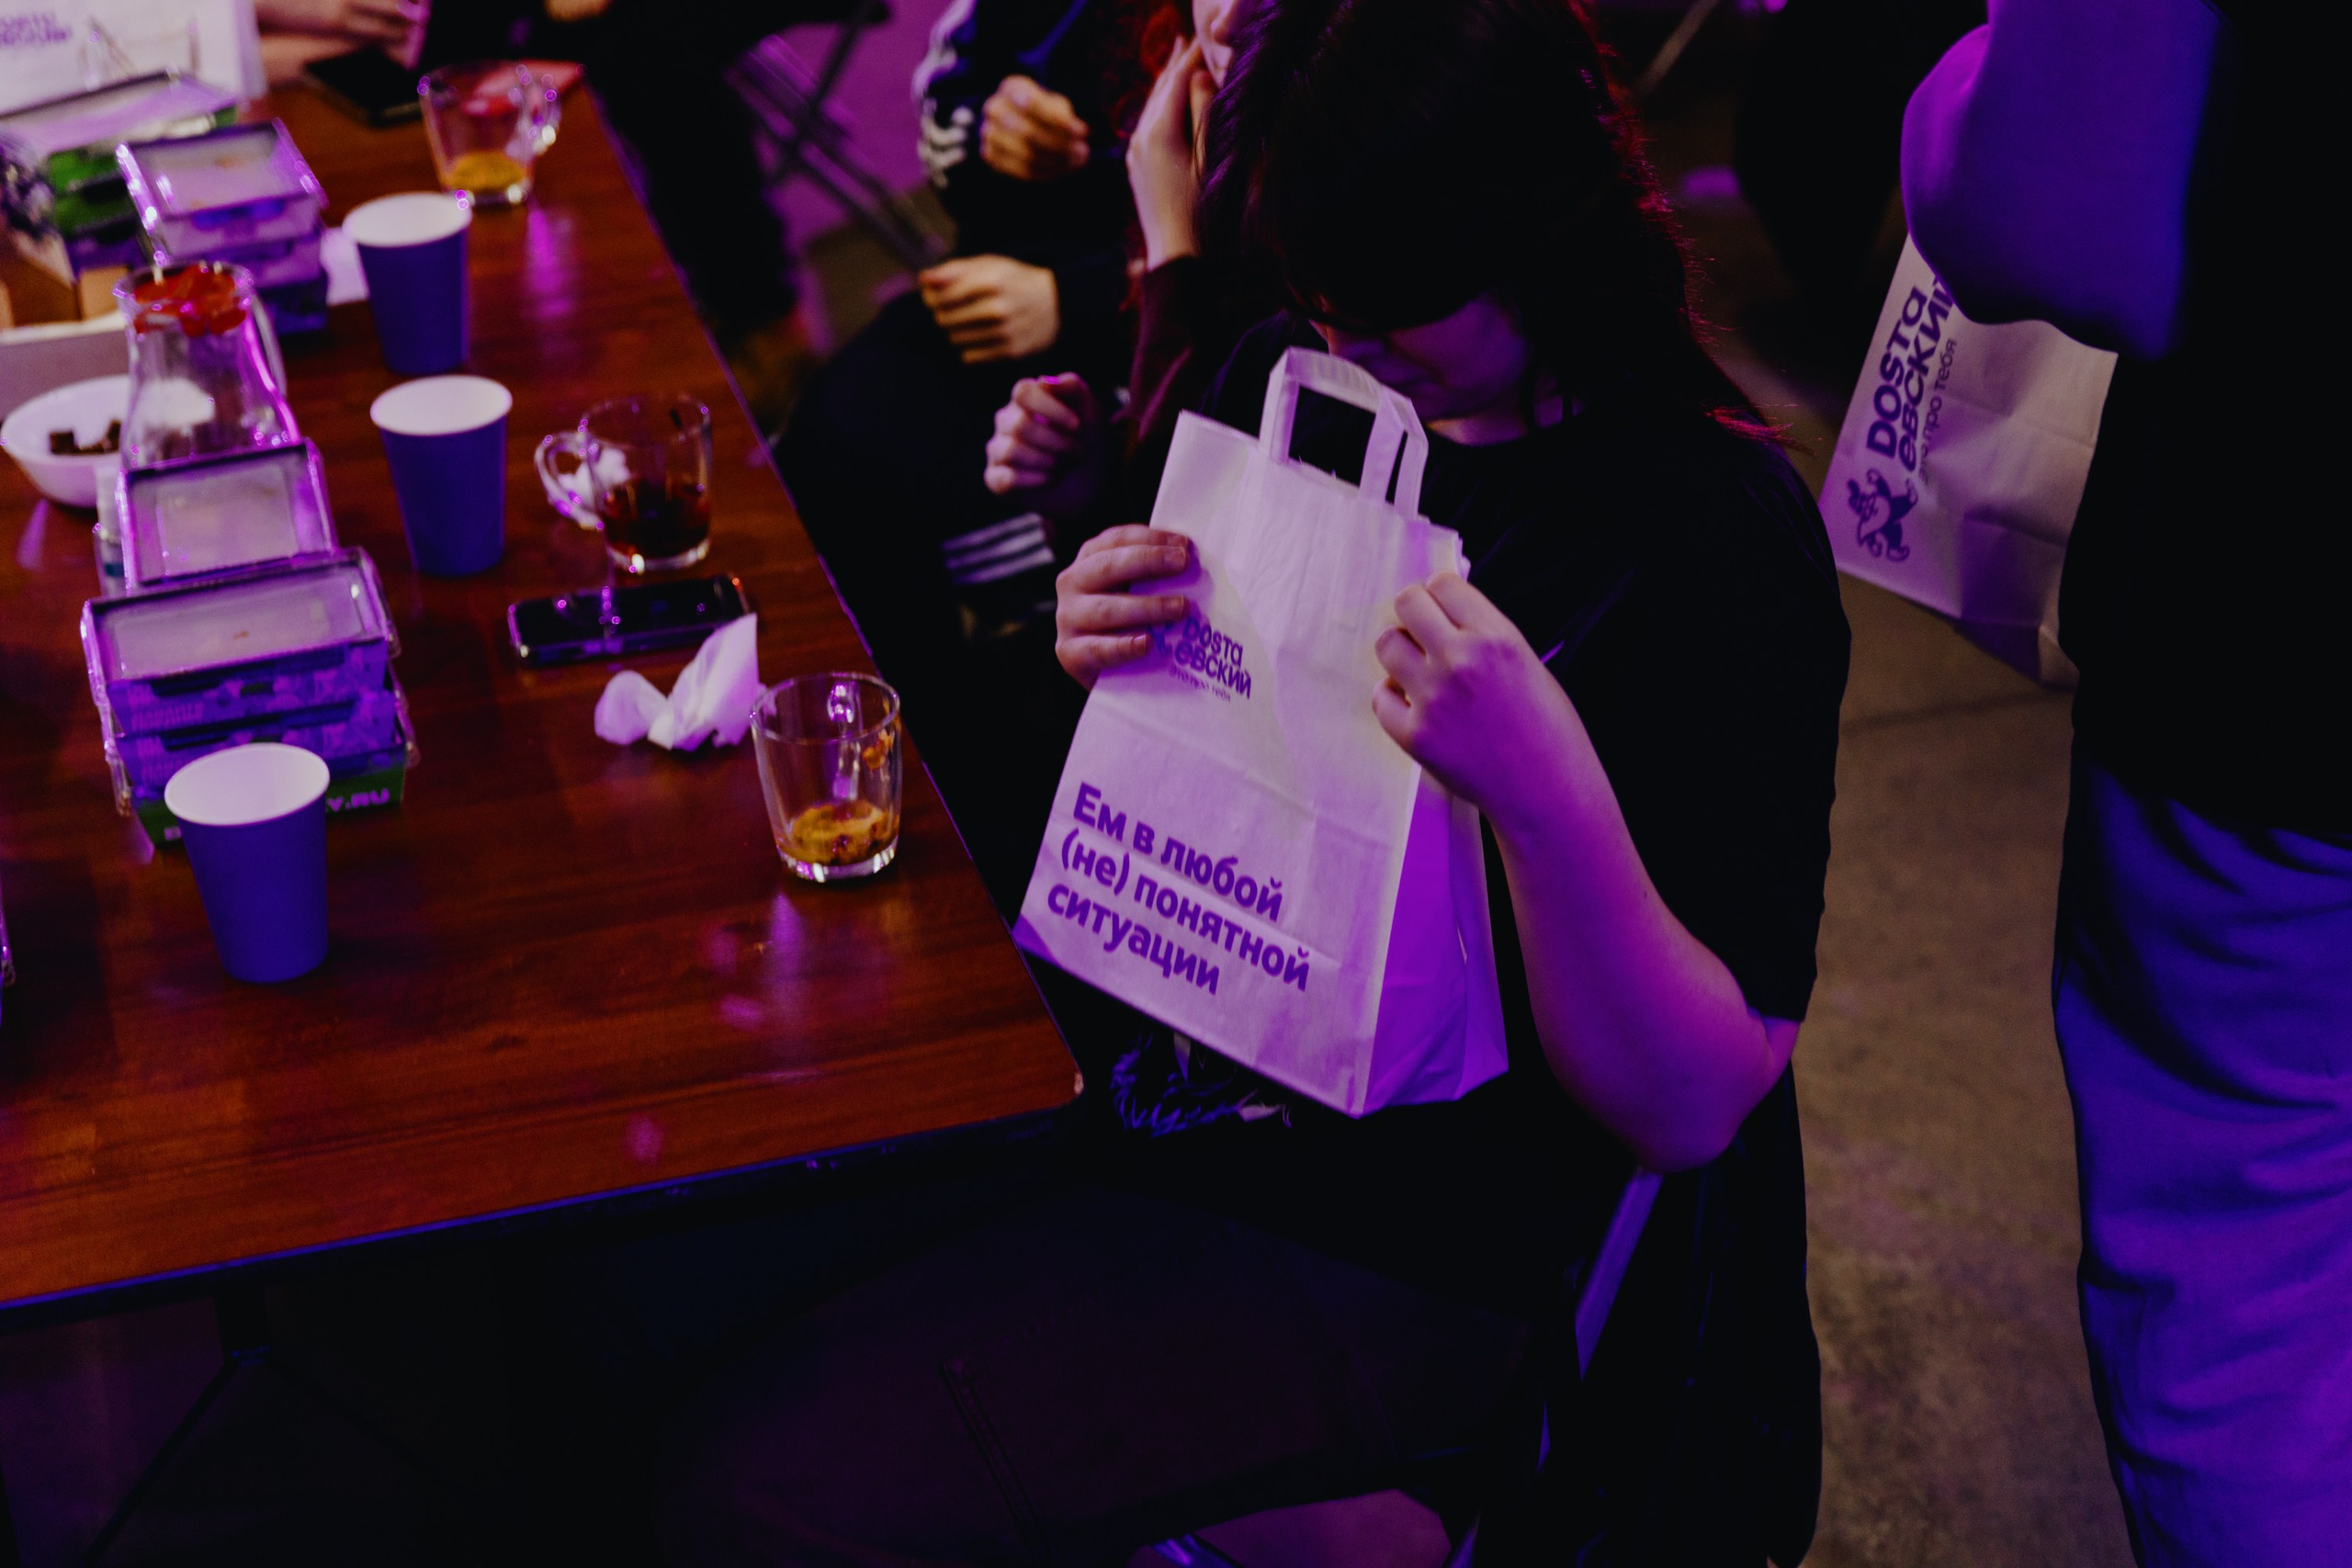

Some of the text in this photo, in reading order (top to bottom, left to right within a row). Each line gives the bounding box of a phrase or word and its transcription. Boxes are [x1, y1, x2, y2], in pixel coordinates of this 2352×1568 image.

[1934, 338, 1957, 391] тебя
[1175, 641, 1251, 699] евский
[1073, 782, 1283, 922] Ем в любой
[1047, 884, 1219, 995] ситуации
[1061, 828, 1309, 992] (не) понятной
